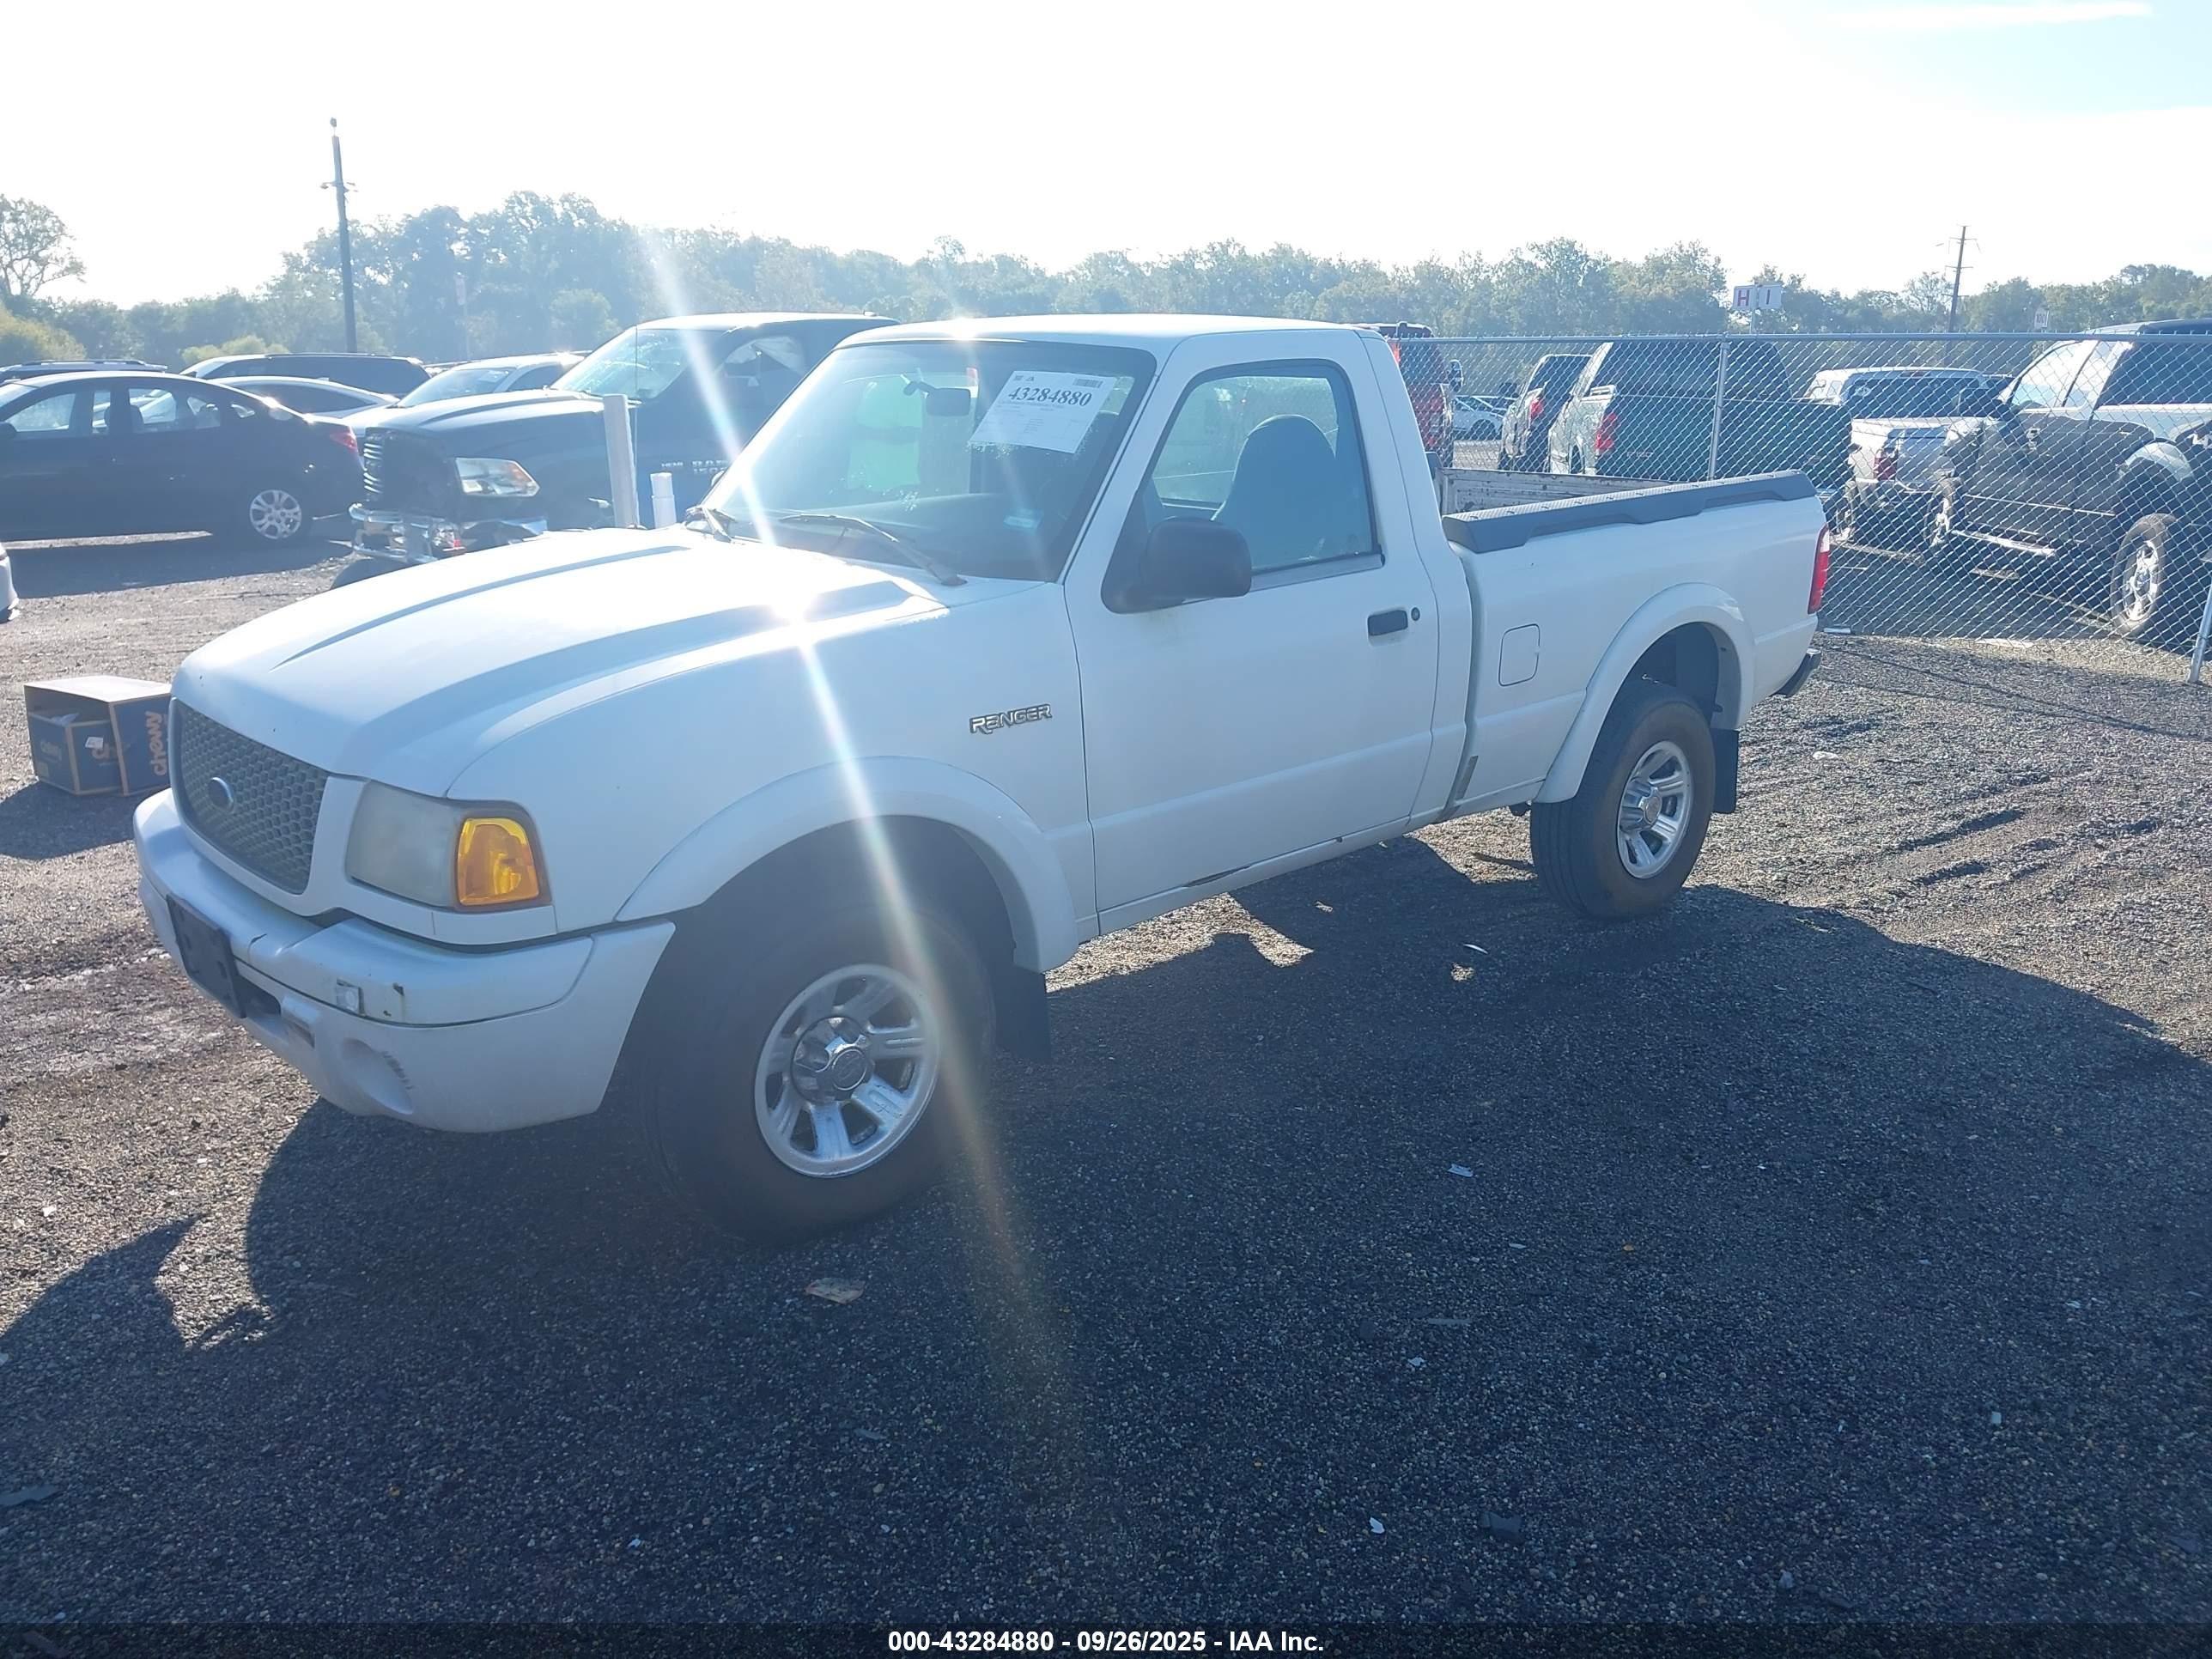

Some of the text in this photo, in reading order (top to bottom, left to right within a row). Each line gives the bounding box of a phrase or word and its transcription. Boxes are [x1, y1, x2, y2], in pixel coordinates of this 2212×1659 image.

[1737, 289, 1750, 307] H
[1008, 386, 1092, 407] 43284880
[969, 703, 1053, 735] RANGER
[144, 710, 167, 776] chewy
